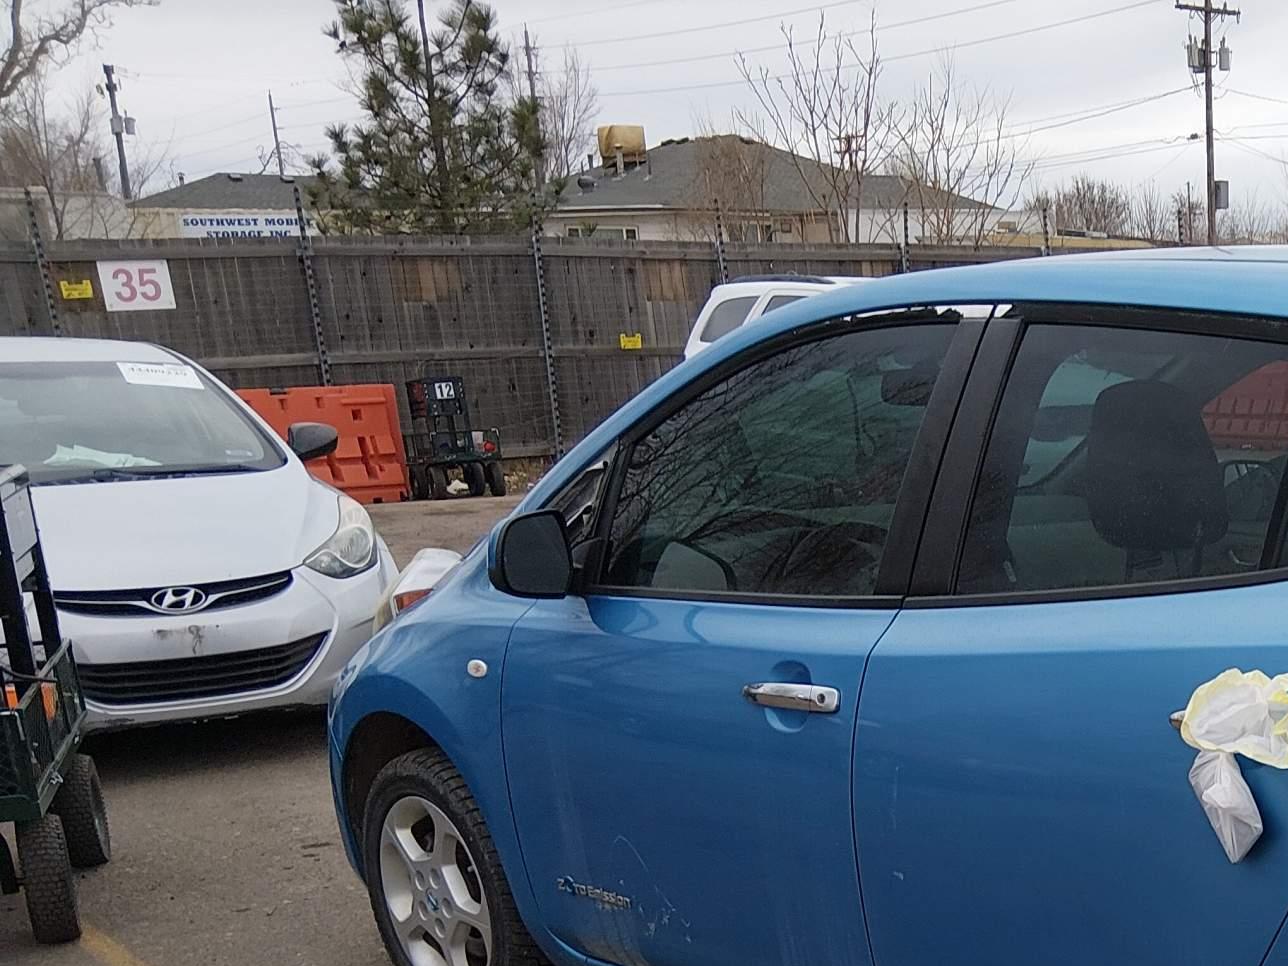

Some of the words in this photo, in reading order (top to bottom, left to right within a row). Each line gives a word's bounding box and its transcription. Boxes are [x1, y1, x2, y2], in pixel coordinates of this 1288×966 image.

[183, 218, 258, 227] SOUTHWEST
[264, 218, 312, 228] MOBI
[112, 267, 161, 302] 35
[437, 383, 454, 398] 12
